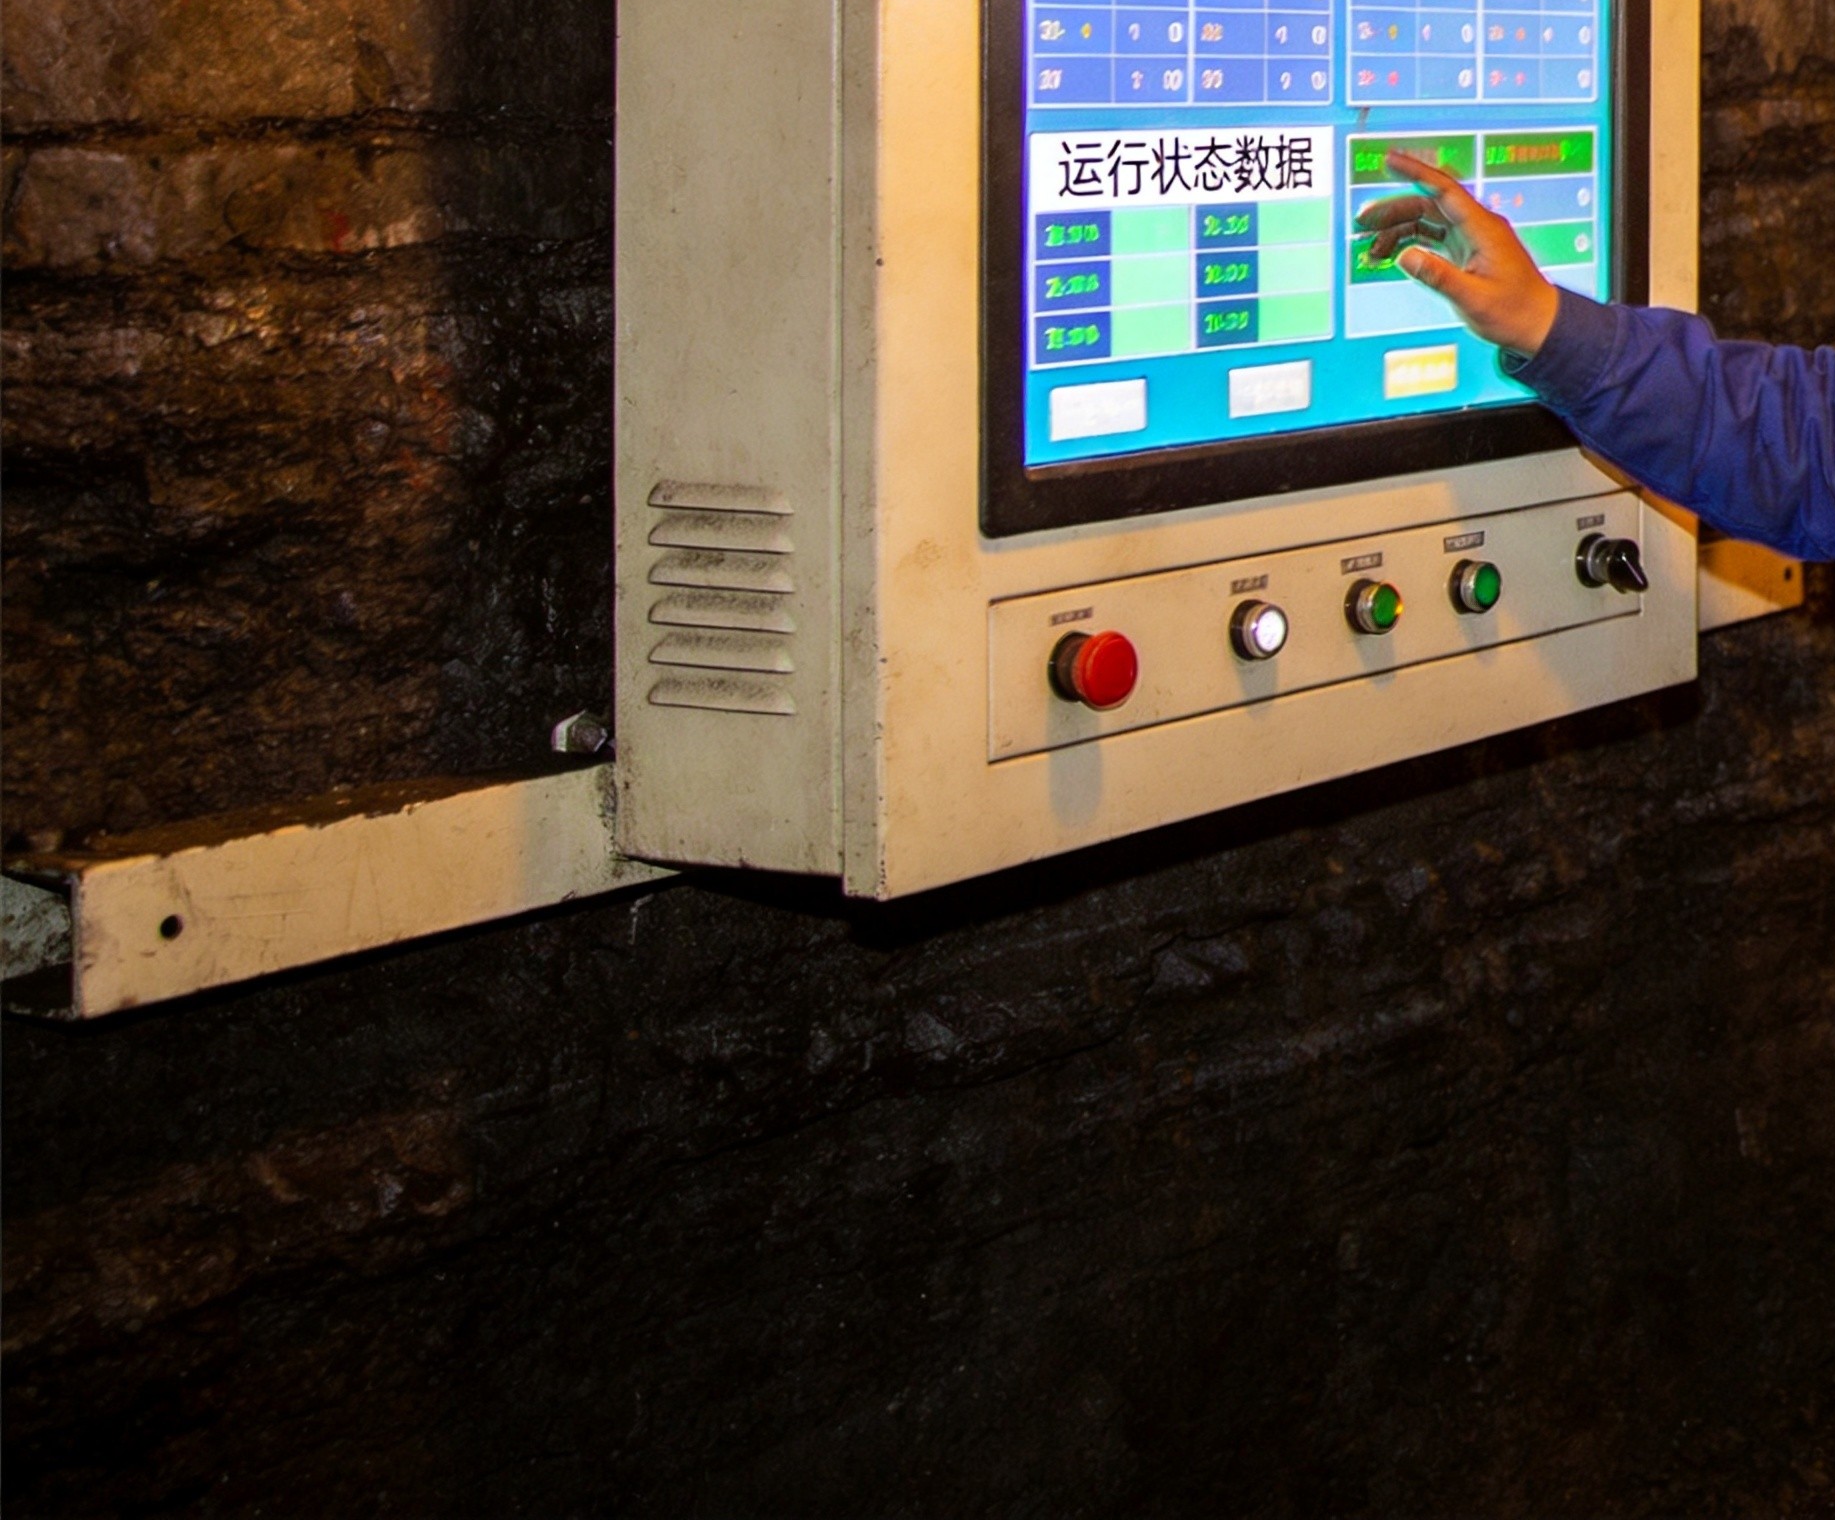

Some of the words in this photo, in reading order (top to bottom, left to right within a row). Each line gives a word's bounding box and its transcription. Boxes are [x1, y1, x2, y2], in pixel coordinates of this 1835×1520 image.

[1058, 134, 1313, 197] 运行状态数据
